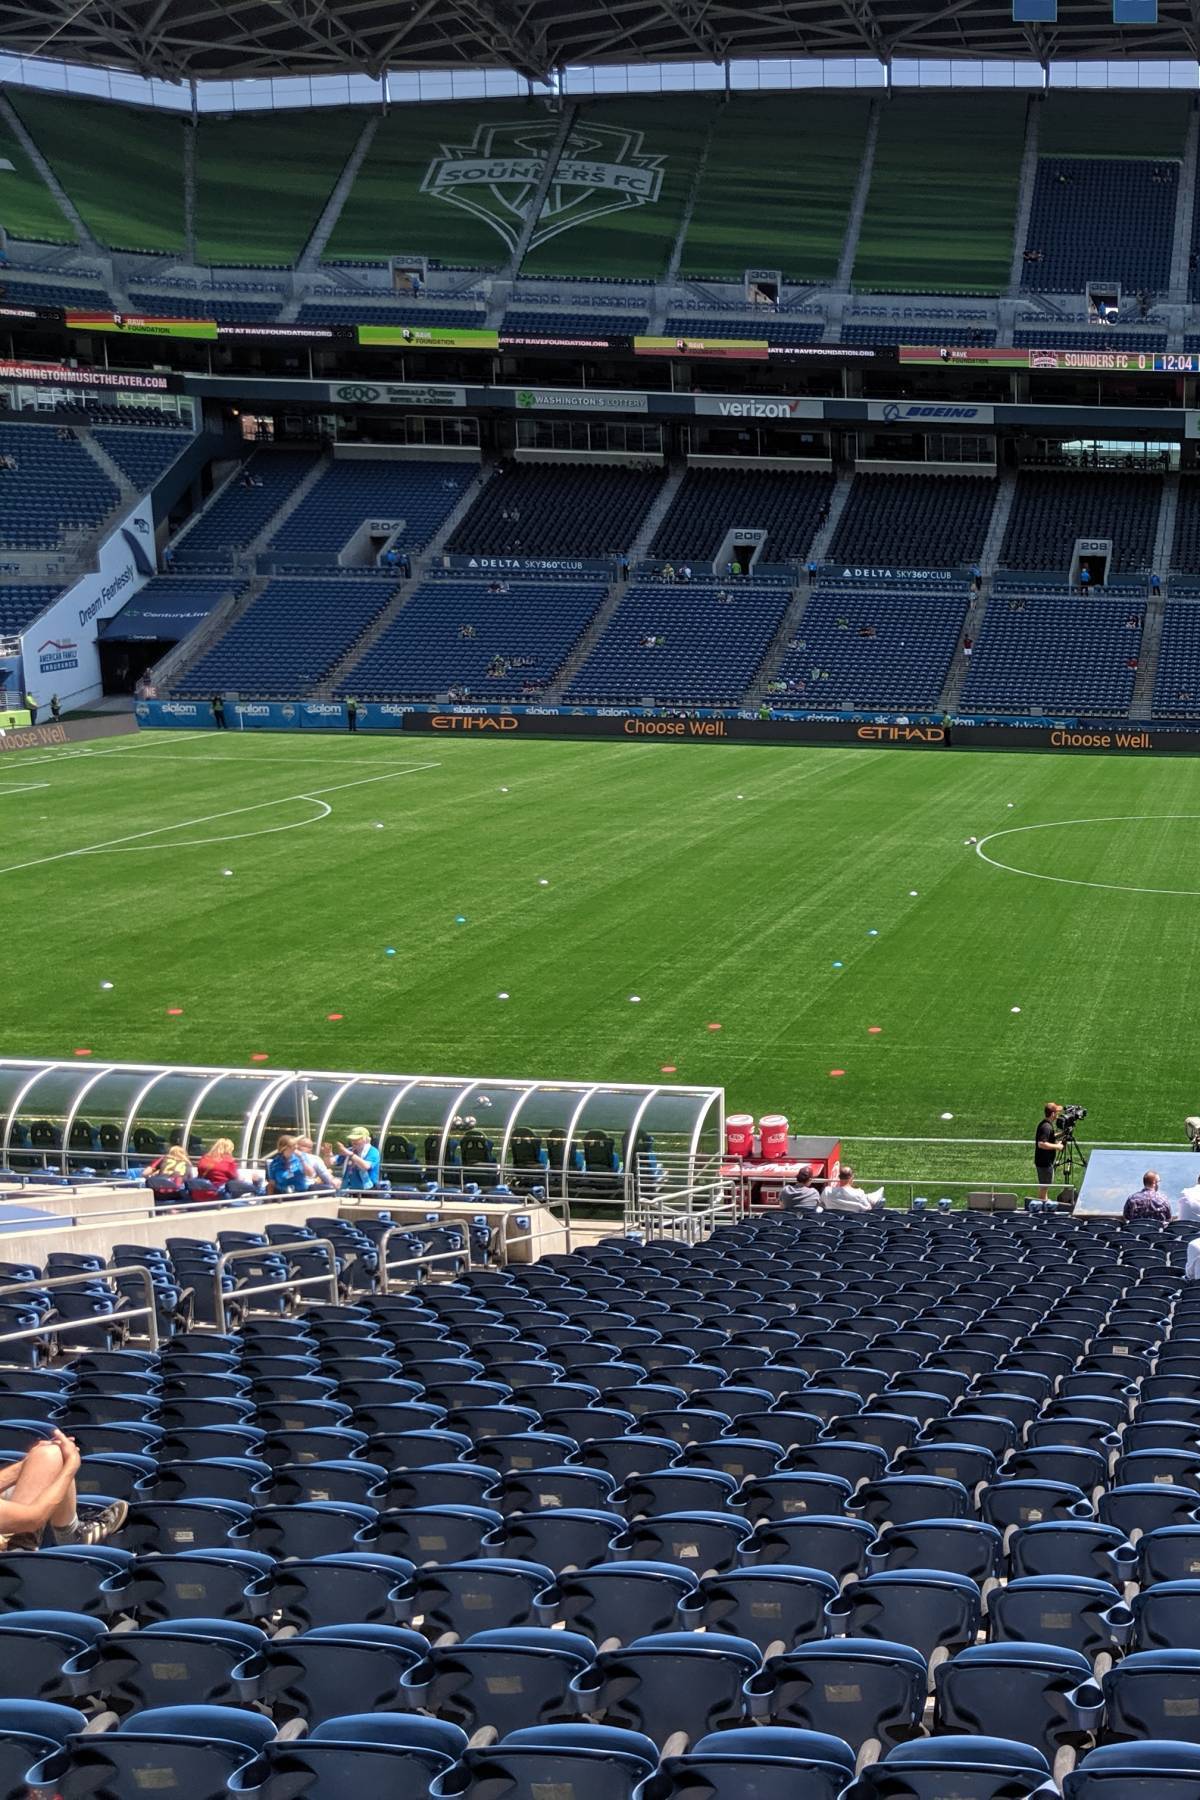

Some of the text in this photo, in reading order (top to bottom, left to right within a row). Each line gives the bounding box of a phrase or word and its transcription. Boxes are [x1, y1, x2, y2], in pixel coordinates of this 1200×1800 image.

[614, 174, 648, 191] FC
[396, 256, 424, 265] 304
[128, 325, 170, 334] FOUNDATION
[1065, 354, 1114, 368] SOUNDERS
[1116, 355, 1128, 368] FC
[1138, 355, 1145, 369] 0
[1161, 355, 1192, 371] 12:04
[535, 396, 645, 408] WASHINGTON'S LOTTERY
[719, 399, 790, 418] verizon
[906, 406, 978, 418] BOEING
[371, 522, 399, 531] 204
[481, 559, 520, 568] DELTA
[855, 569, 892, 577] DELTA
[79, 564, 134, 627] Dream Fearlessly
[453, 705, 487, 714] slalom
[526, 706, 559, 715] slalom
[431, 716, 519, 730] ETIHAD
[624, 719, 728, 736] Choose Well.
[0, 724, 71, 750] hoose Well.
[857, 726, 944, 740] ETIHAD
[1051, 731, 1153, 748] Choose Well.
